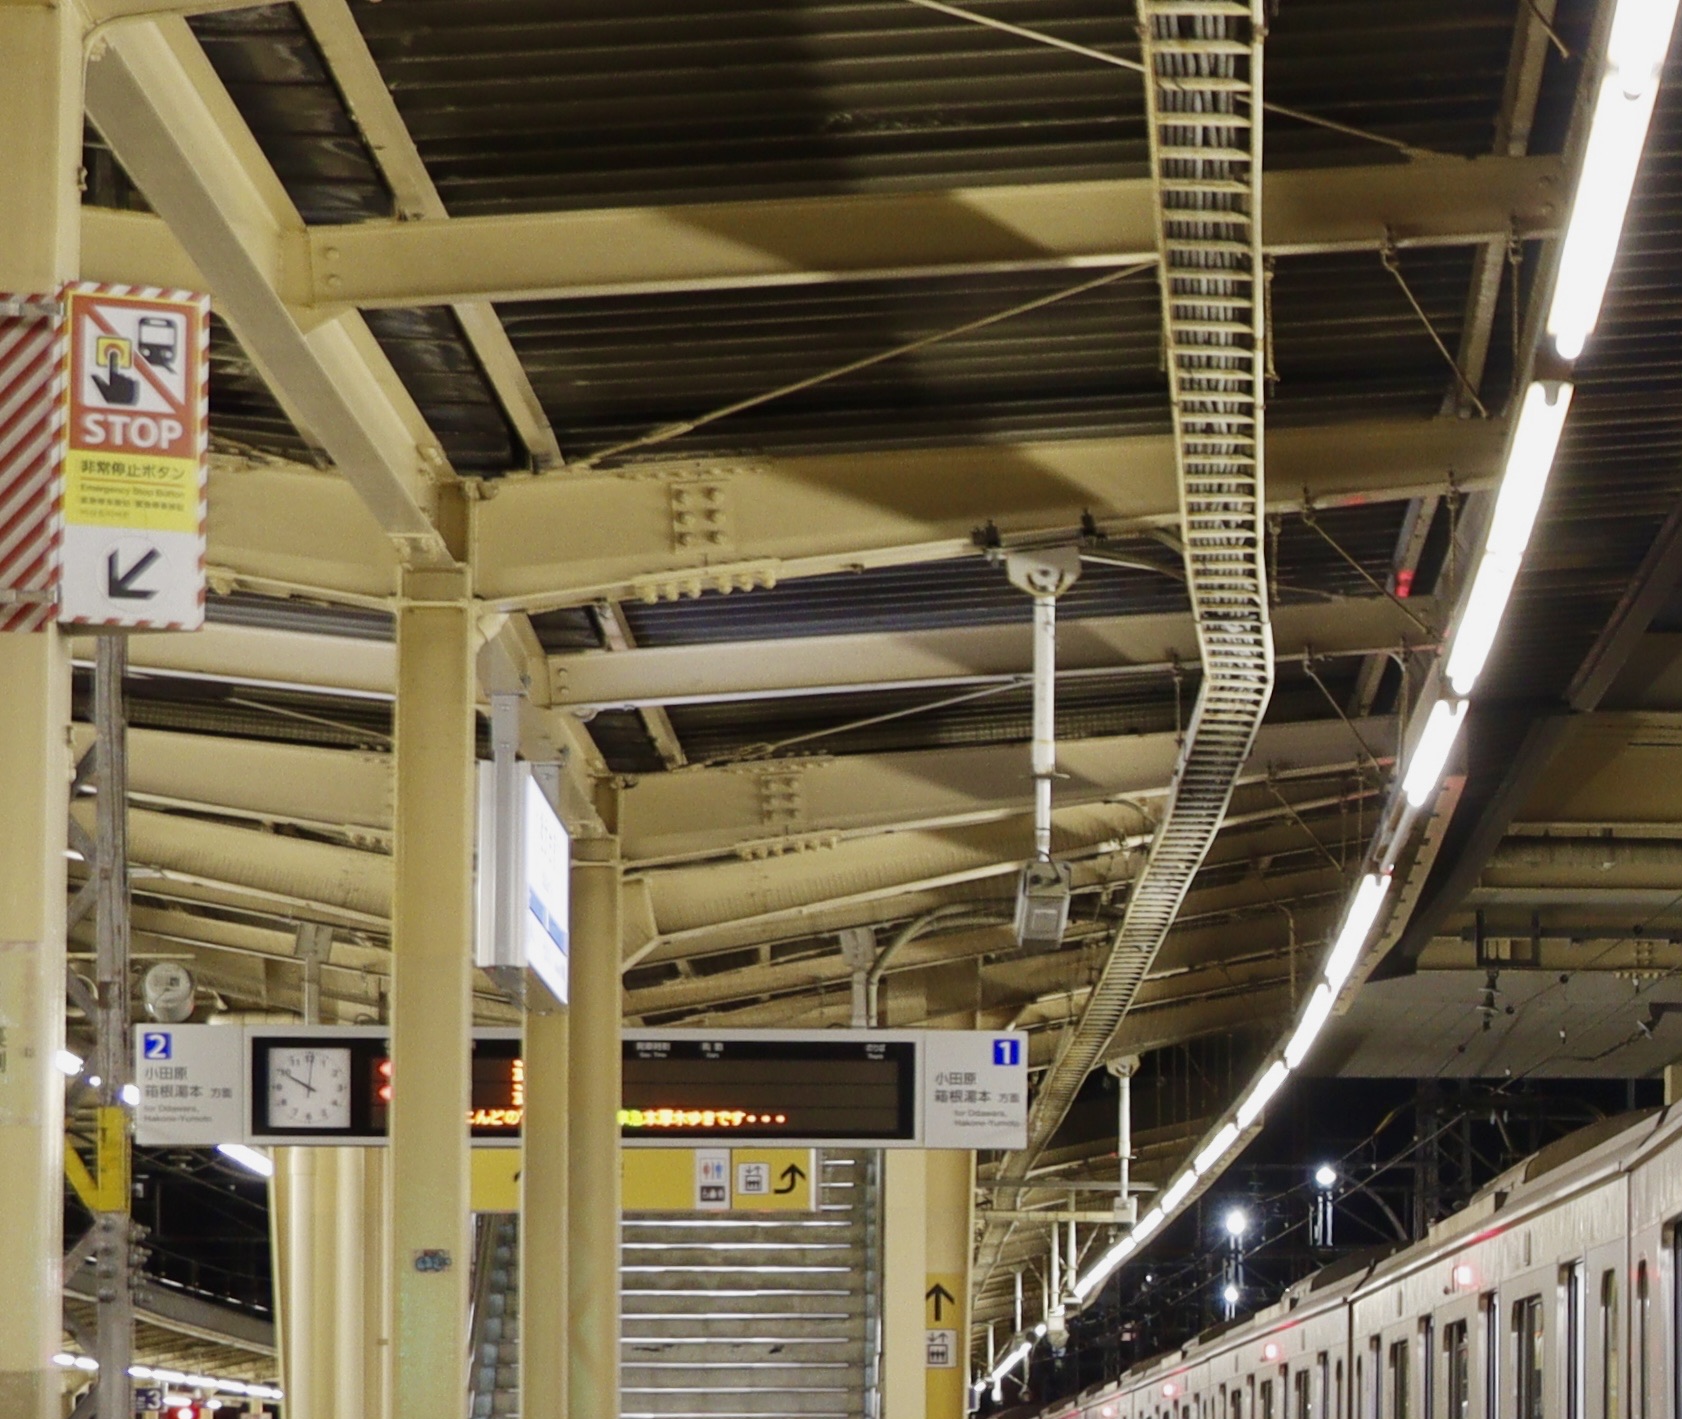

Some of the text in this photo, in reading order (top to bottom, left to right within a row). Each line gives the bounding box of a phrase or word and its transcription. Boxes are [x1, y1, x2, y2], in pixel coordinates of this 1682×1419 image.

[83, 413, 183, 449] STOP
[81, 459, 186, 480] 非常停止ボタン
[147, 1034, 167, 1059] 2
[998, 1040, 1012, 1065] 1
[145, 1066, 187, 1080] 小田原
[936, 1072, 977, 1085] 小田原
[145, 1085, 232, 1098] 箱根湯本 方面
[935, 1089, 1020, 1103] 箱根湯本 方面
